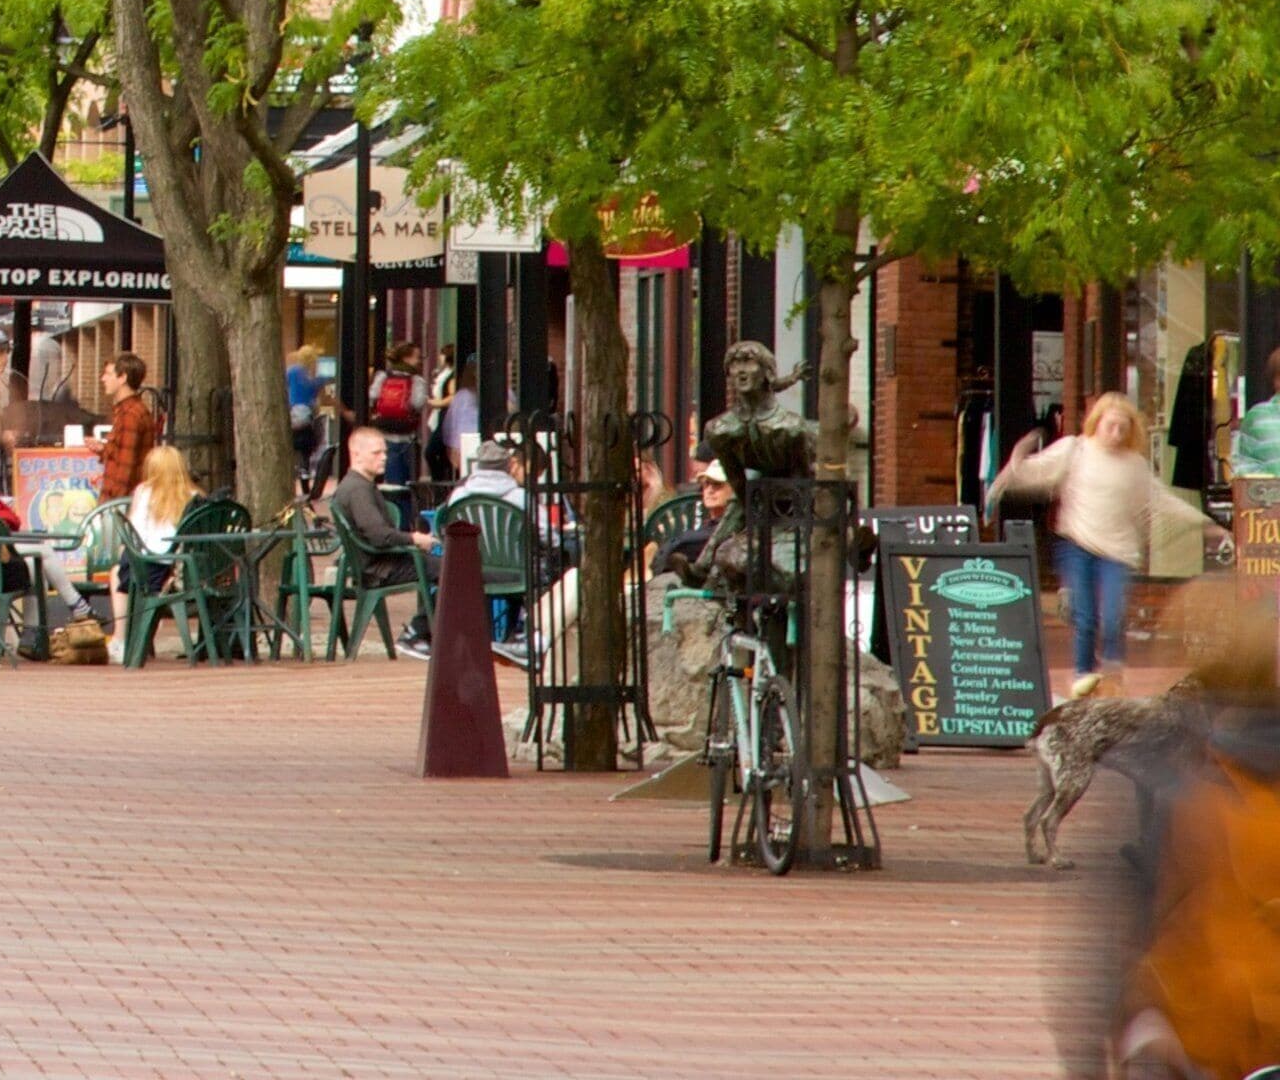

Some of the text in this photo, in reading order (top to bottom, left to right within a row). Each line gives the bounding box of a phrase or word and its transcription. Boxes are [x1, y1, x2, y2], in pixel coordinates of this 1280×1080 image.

[6, 203, 55, 217] THE
[309, 220, 438, 237] STELA MAE
[48, 269, 173, 290] EXPLORING
[19, 456, 104, 474] SPEEDE
[41, 476, 102, 492] EARL
[1240, 507, 1280, 544] Tra
[947, 607, 998, 620] Womens
[948, 622, 997, 635] & Mens
[900, 556, 940, 735] VINTAGE
[949, 635, 1024, 649] New Clothes
[951, 649, 1020, 662] Accessories
[951, 662, 1012, 676] Costumes
[952, 676, 1035, 691] Local Artists
[953, 689, 1000, 704] Jewelry
[955, 703, 1035, 719] Hipster Crap
